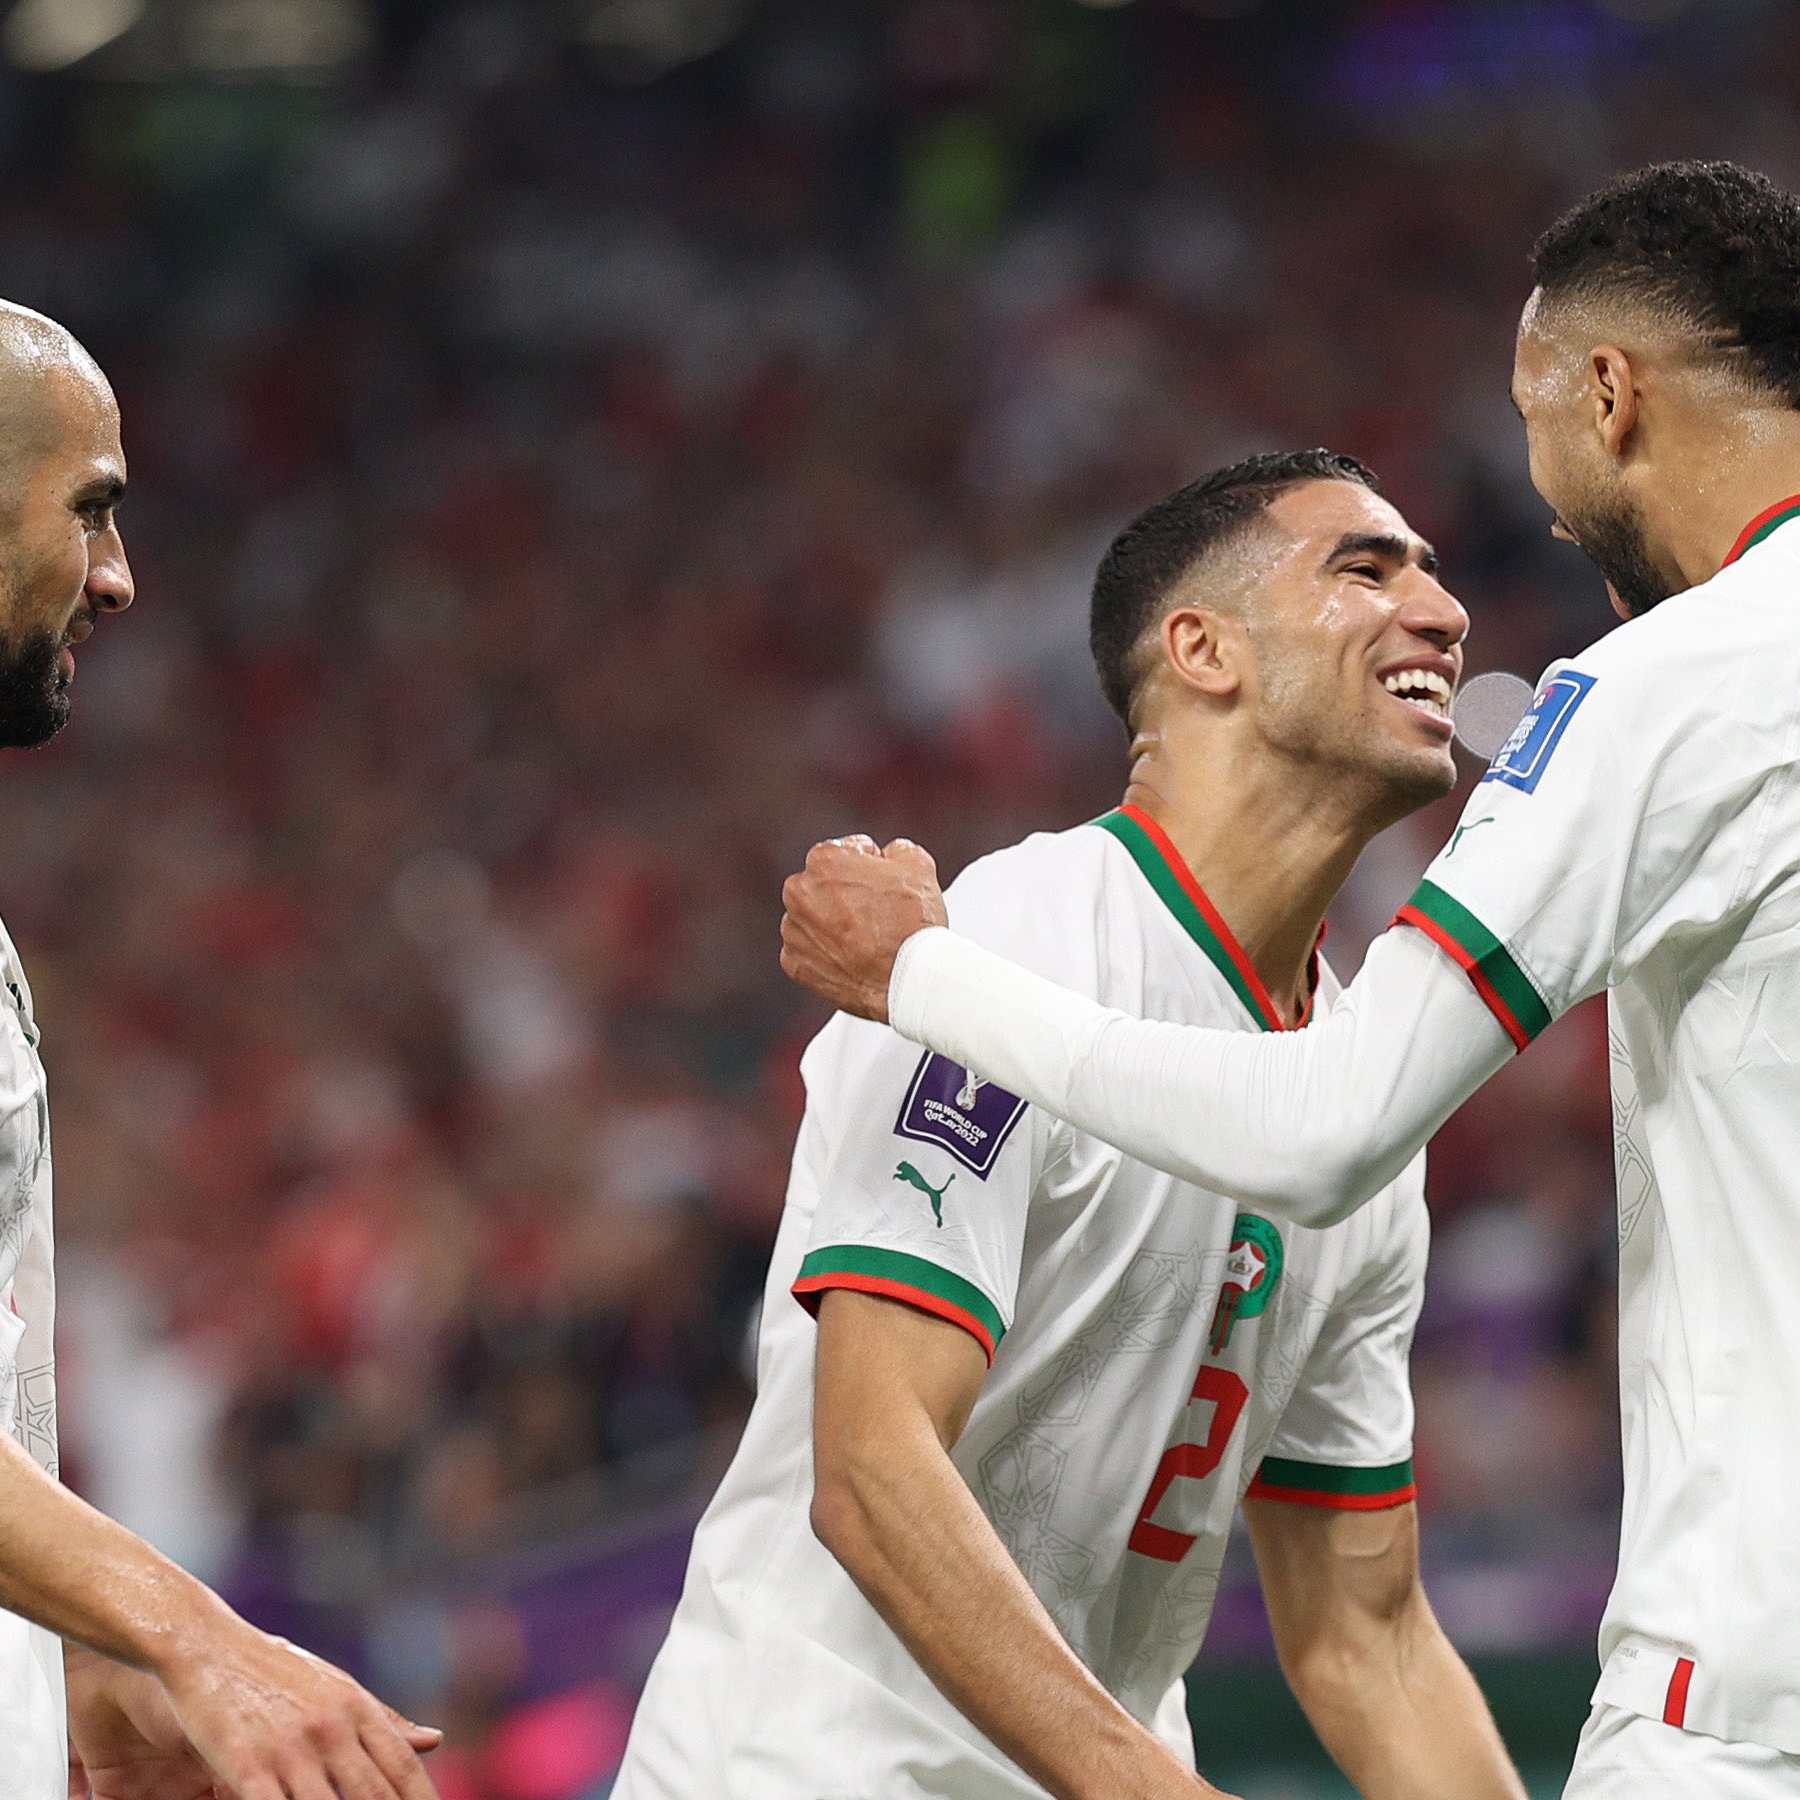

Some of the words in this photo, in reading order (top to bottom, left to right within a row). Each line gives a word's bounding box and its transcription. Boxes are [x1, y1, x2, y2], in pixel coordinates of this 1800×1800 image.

[923, 1098, 943, 1112] FIFA
[943, 1104, 973, 1130] WORLD
[970, 1124, 989, 1140] CUP
[1127, 1365, 1249, 1562] 2
